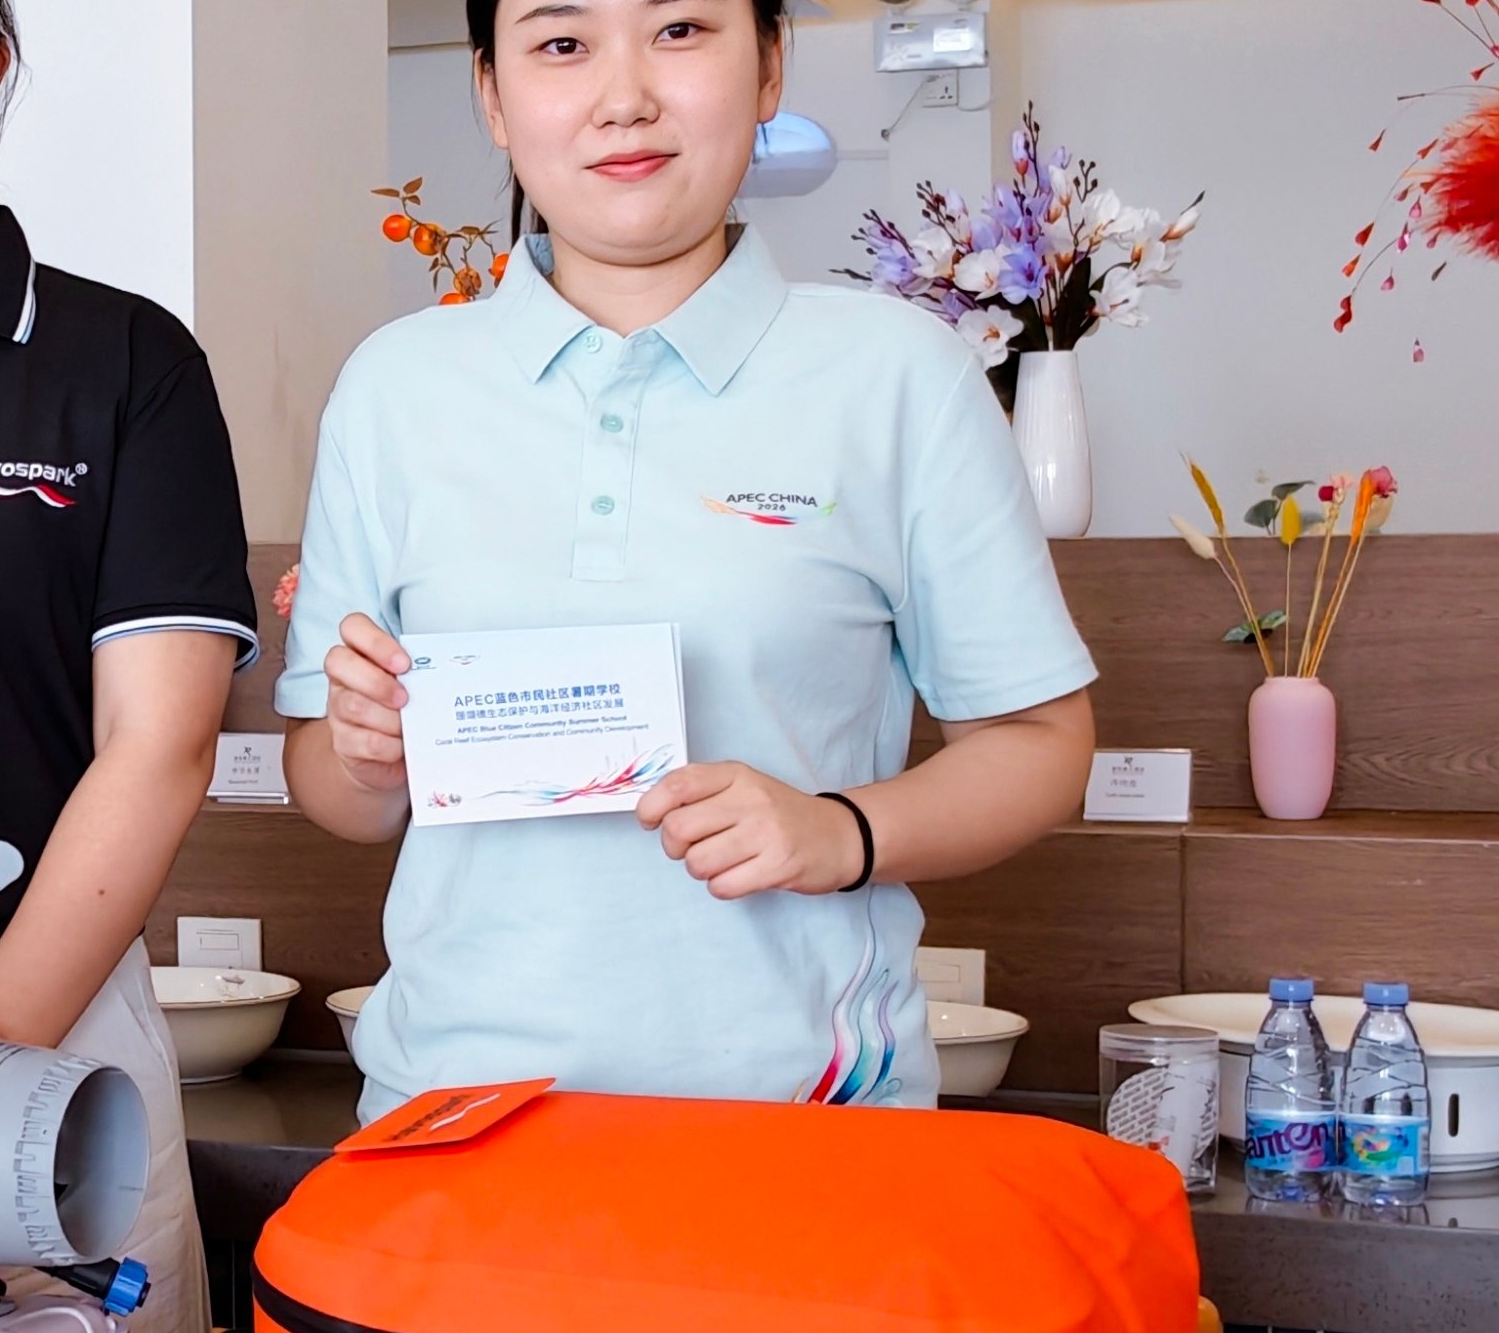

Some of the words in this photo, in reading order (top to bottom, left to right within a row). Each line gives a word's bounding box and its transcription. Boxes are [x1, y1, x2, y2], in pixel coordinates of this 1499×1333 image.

[726, 493, 766, 503] APEC
[768, 493, 818, 507] CHINA
[757, 503, 786, 511] 2026
[1244, 1122, 1330, 1160] anten
